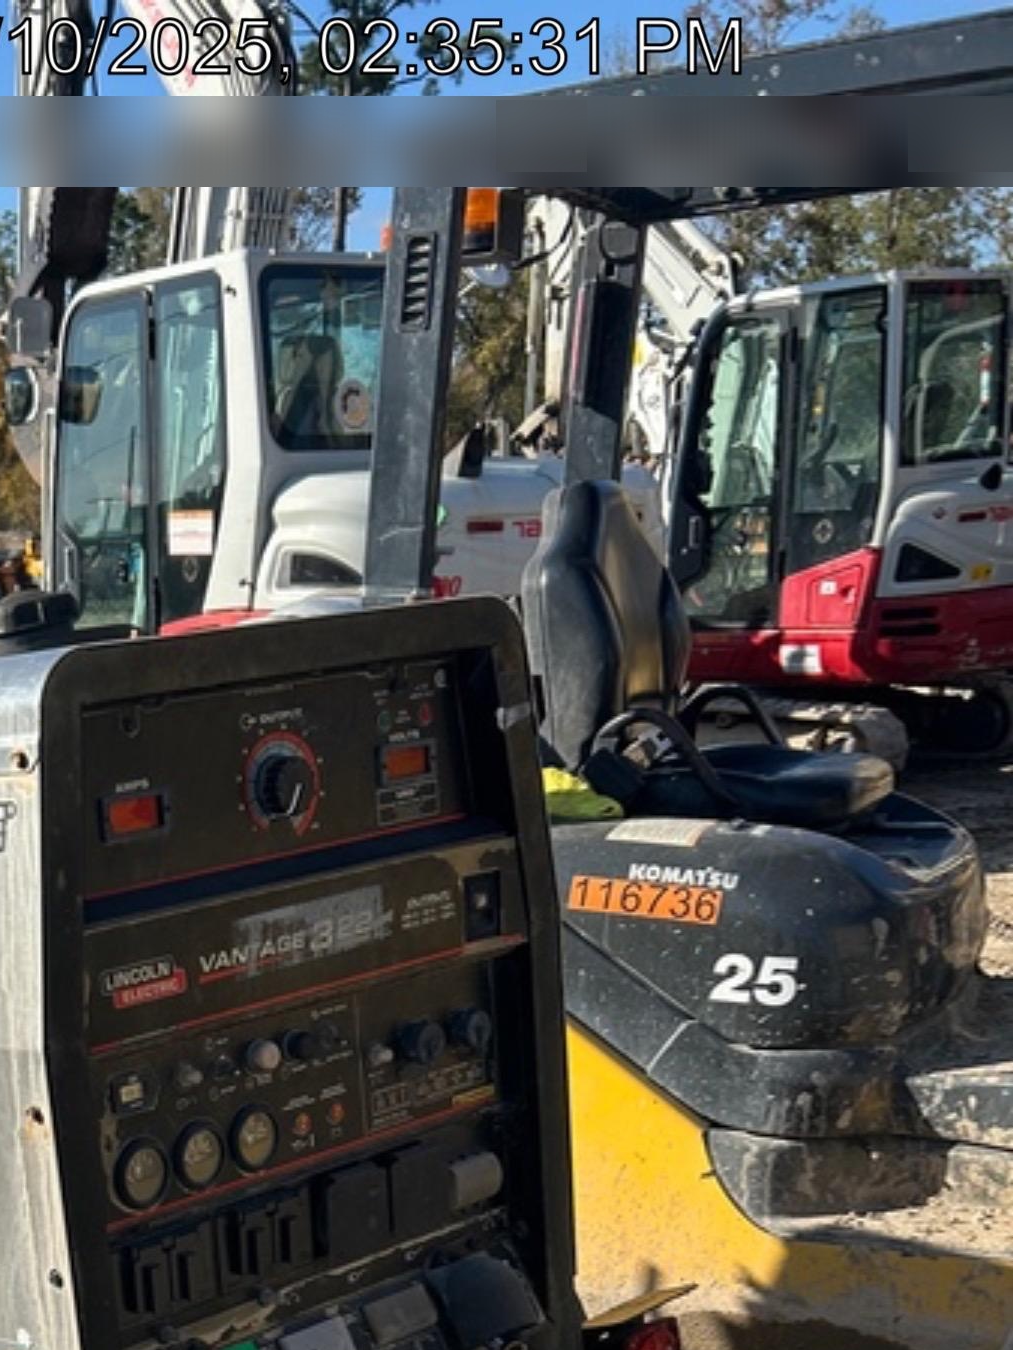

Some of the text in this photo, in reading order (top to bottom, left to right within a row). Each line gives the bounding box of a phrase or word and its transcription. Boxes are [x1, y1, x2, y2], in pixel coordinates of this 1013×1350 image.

[628, 863, 739, 889] KOMATSU
[573, 878, 719, 922] 116736
[105, 961, 171, 991] LINCOLN
[707, 953, 799, 1007] 25
